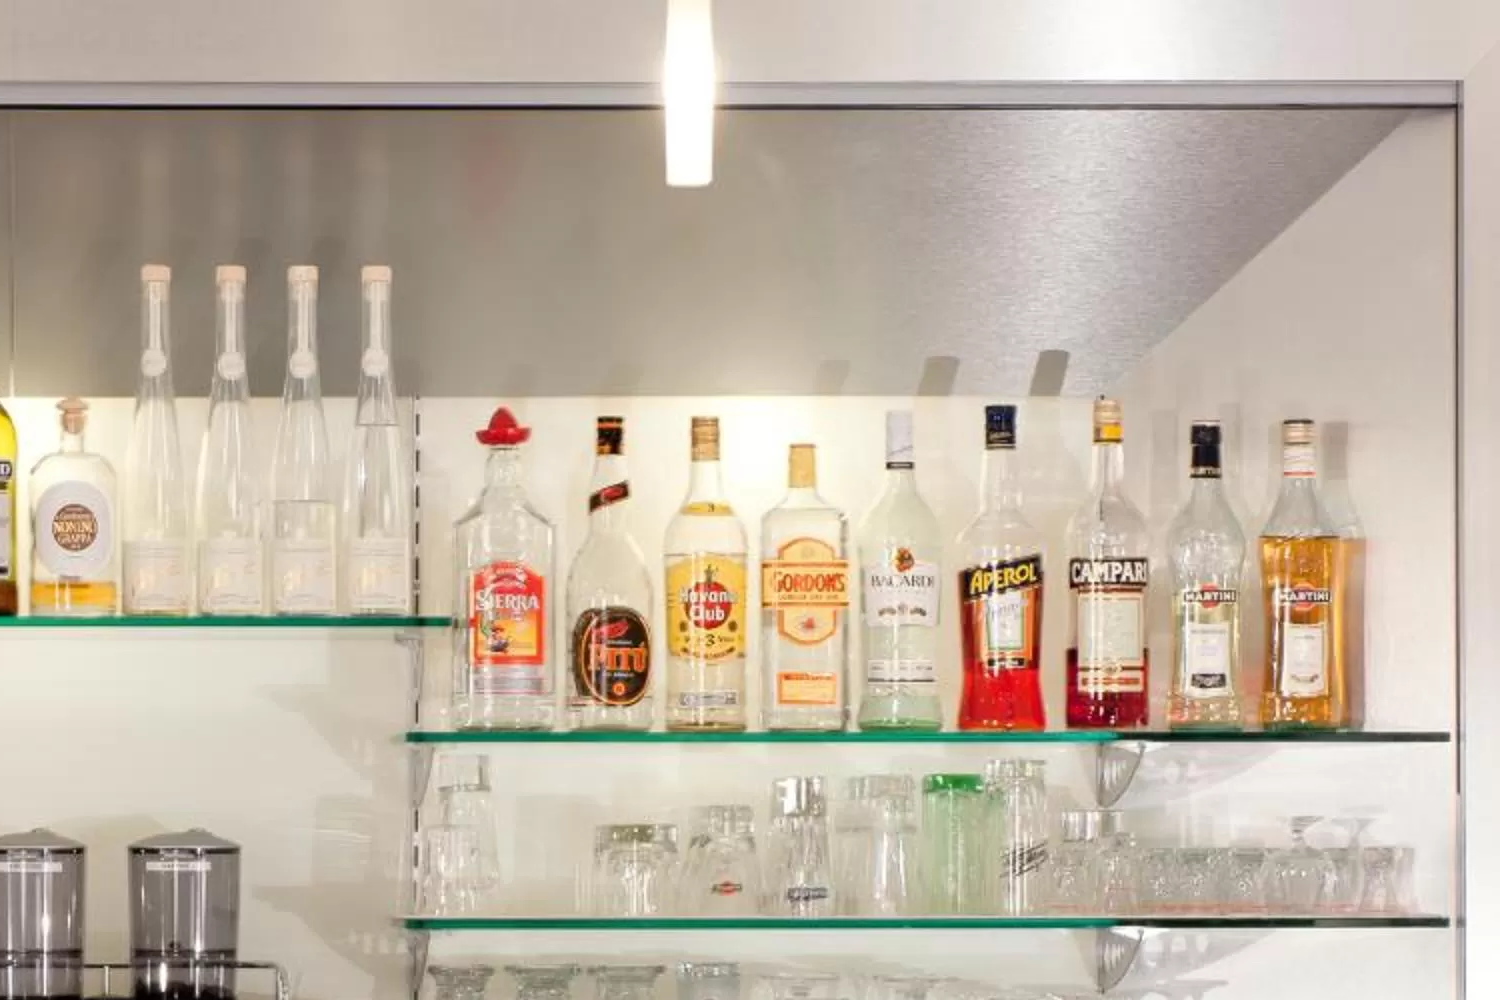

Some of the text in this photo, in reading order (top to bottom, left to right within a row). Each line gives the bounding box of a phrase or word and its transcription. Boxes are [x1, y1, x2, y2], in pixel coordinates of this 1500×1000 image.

[871, 575, 935, 588] BACARDI
[970, 563, 1038, 595] APEROL
[475, 589, 540, 610] SIERRA
[1185, 590, 1236, 601] MARTINI
[1280, 590, 1330, 601] MARTINI
[689, 604, 725, 620] Club
[705, 633, 716, 647] 3
